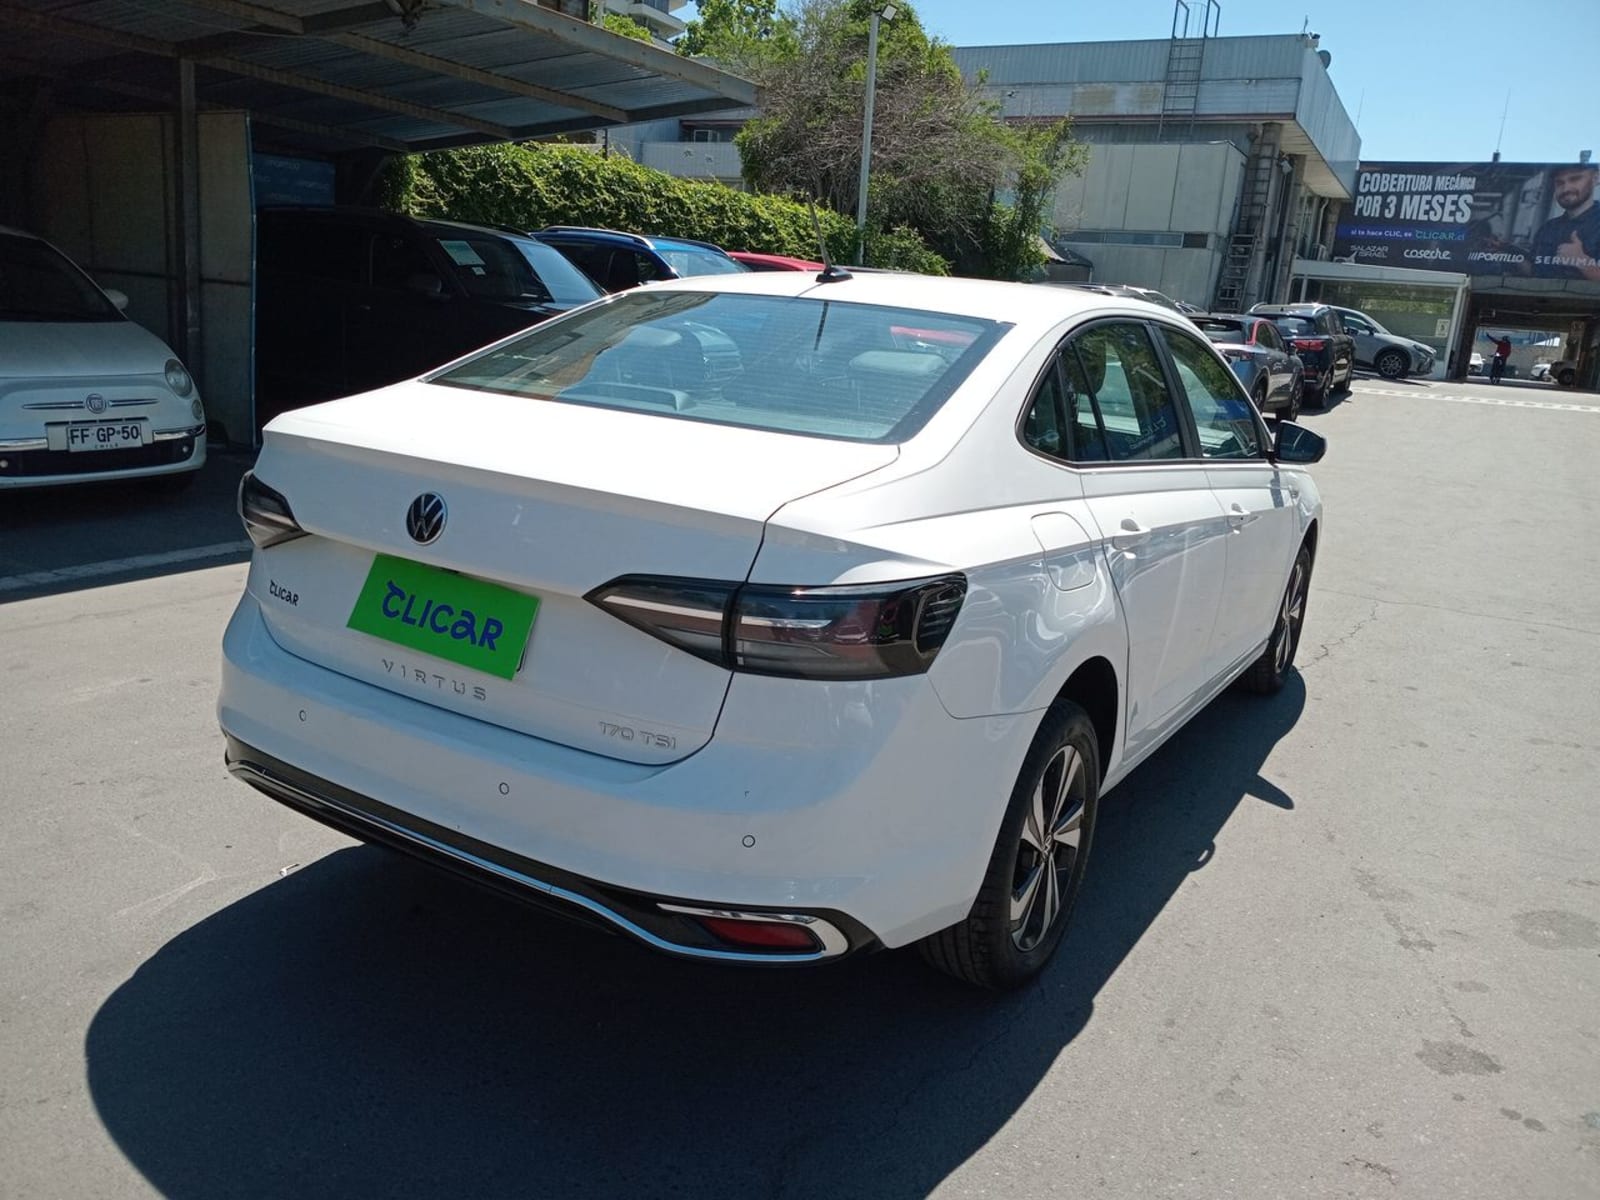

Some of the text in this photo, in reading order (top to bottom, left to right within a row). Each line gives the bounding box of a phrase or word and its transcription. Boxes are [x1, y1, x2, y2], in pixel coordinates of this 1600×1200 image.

[1359, 172, 1432, 192] COBERTURA
[1354, 194, 1474, 223] POR 3 MESES
[1403, 249, 1451, 260] coseche
[381, 658, 487, 701] VIRTUS
[599, 721, 677, 749] 170 TSI
